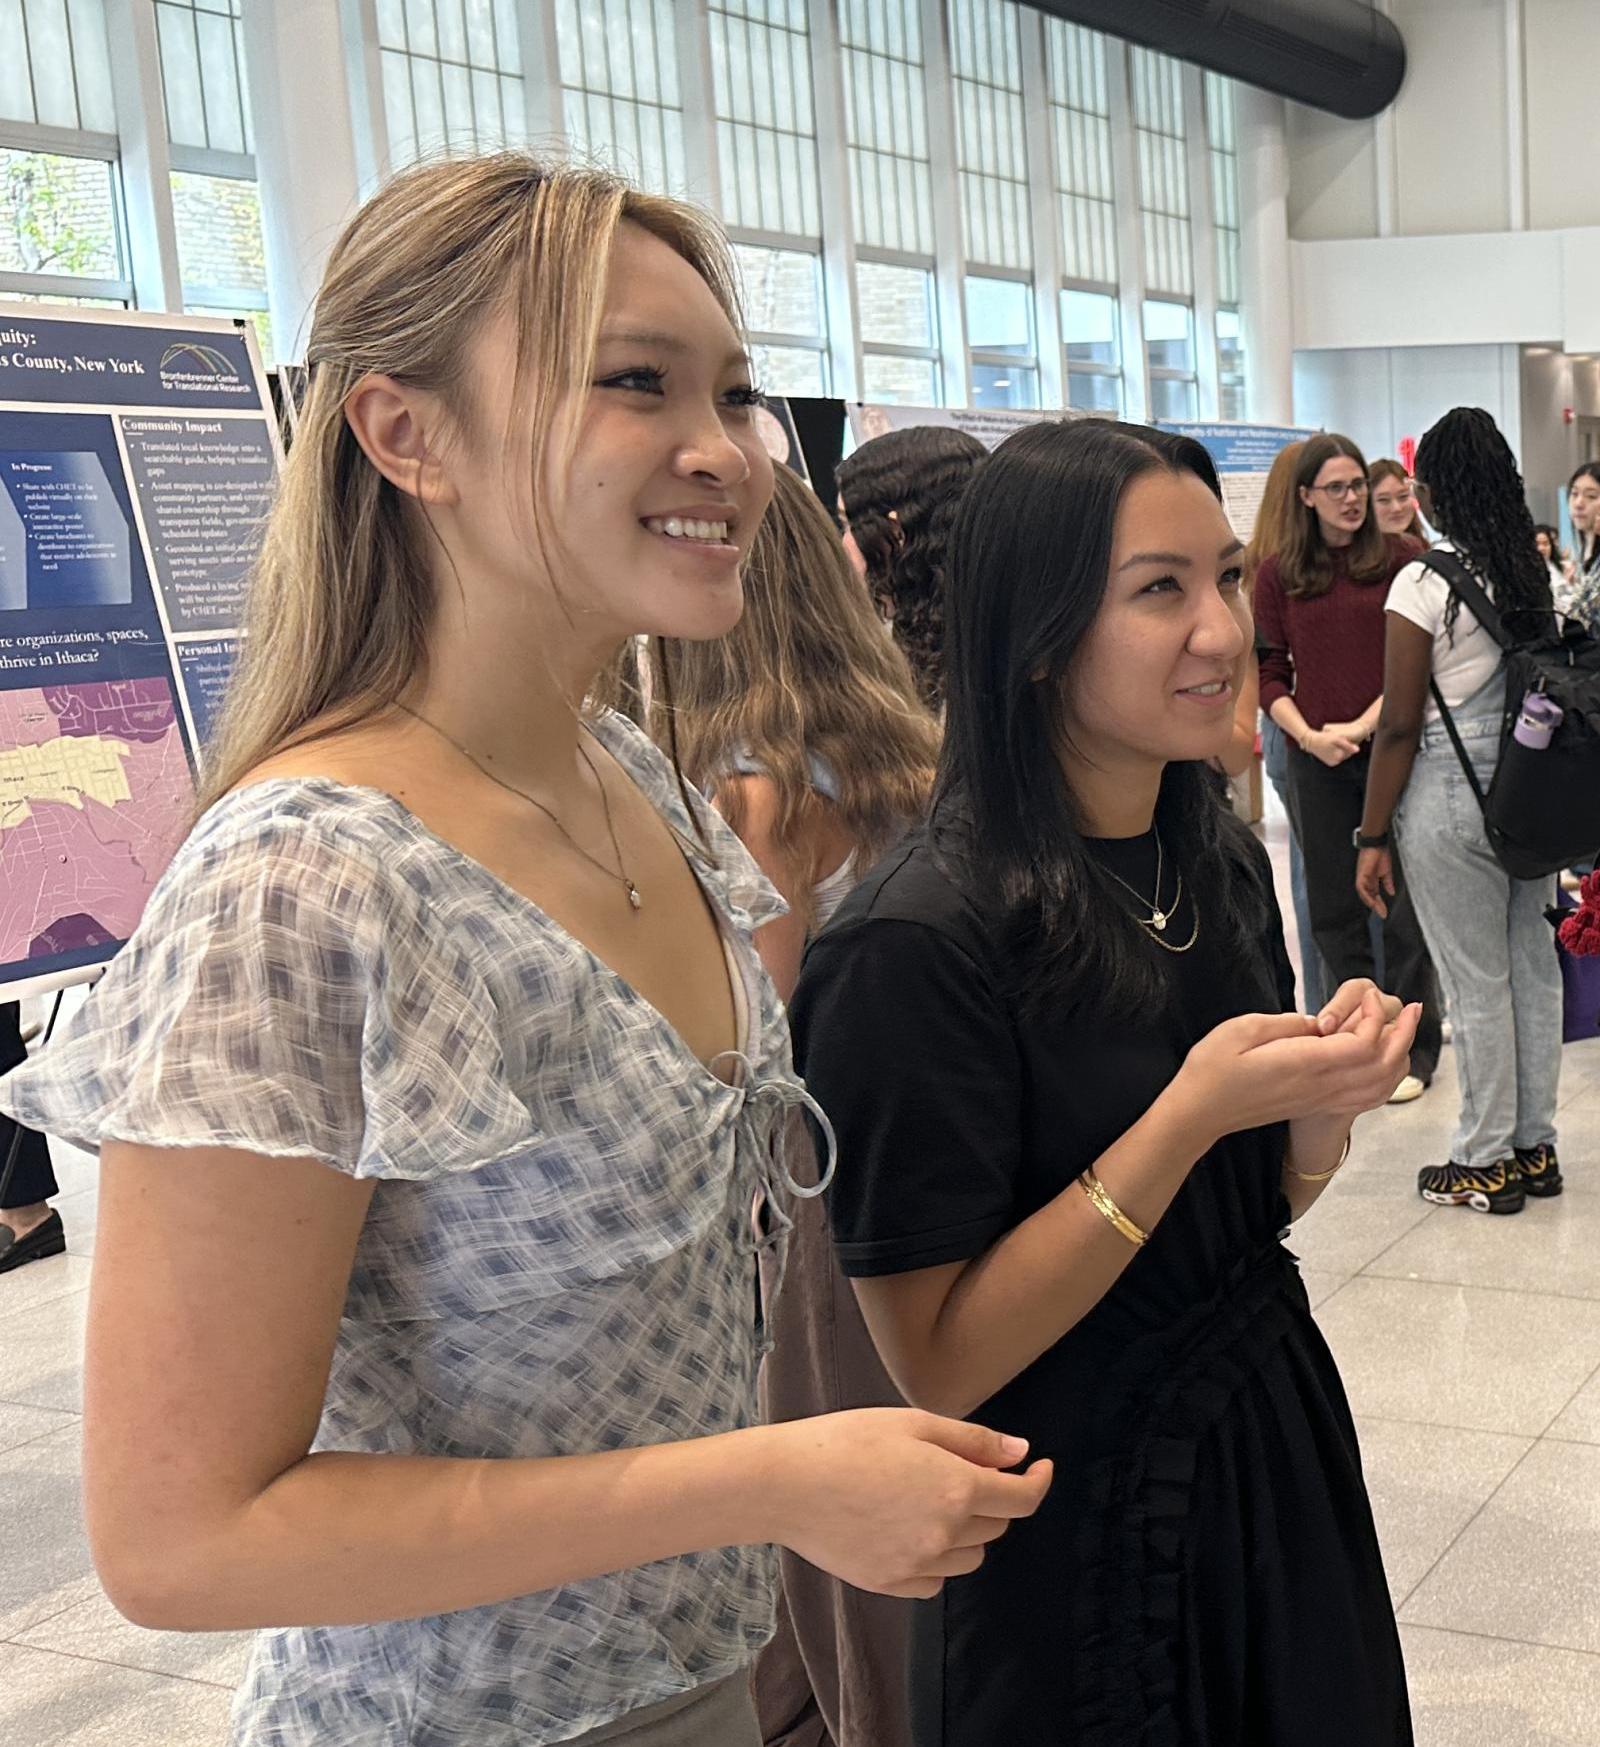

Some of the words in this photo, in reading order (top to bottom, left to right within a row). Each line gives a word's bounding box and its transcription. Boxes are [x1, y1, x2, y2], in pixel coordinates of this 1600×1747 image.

[12, 352, 73, 374] County,
[74, 355, 106, 372] New
[108, 358, 146, 375] York
[215, 373, 240, 384] Center
[122, 418, 183, 434] Community
[184, 420, 223, 435] Impact
[10, 462, 20, 471] In
[20, 462, 53, 473] Progress
[16, 629, 105, 650] organizations,
[106, 628, 149, 644] spaces,
[177, 643, 222, 656] Personal
[0, 653, 37, 669] thrive
[39, 652, 54, 666] in
[55, 648, 100, 665] Ithaca?
